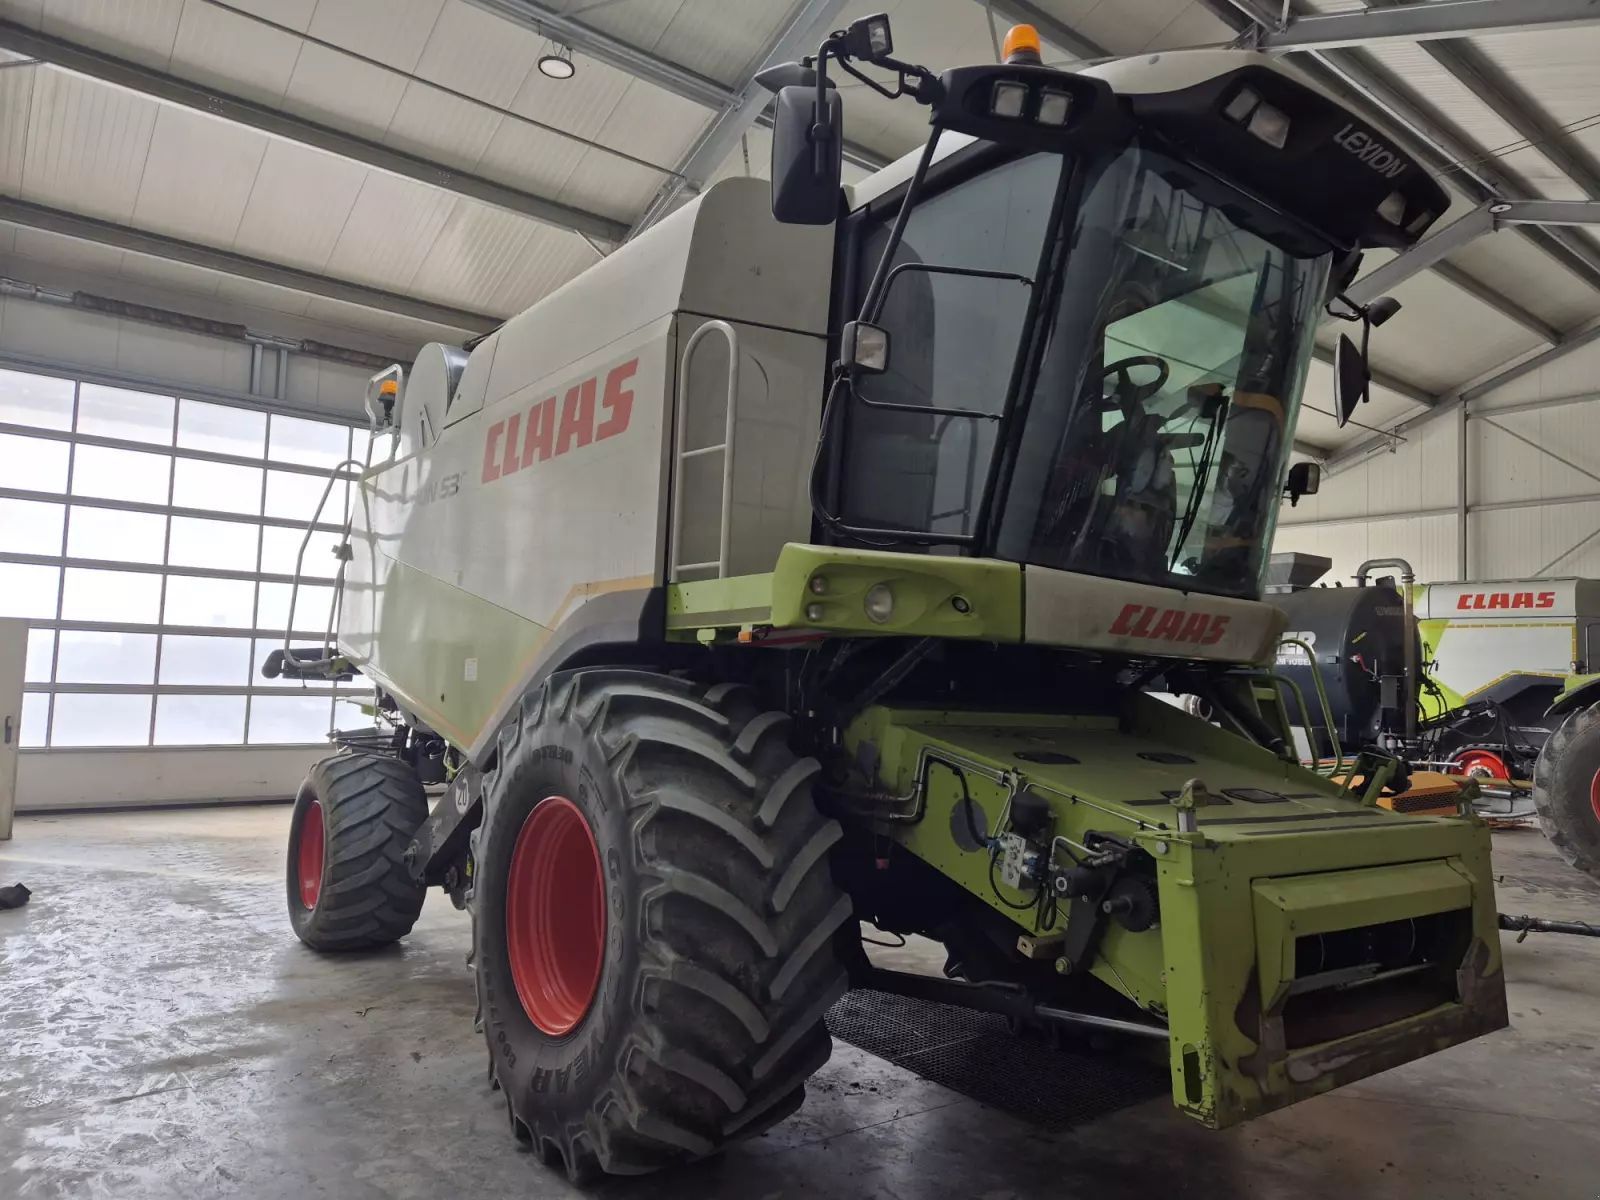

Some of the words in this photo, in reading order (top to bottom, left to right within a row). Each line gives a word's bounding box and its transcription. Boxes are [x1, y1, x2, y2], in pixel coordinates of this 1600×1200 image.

[1333, 123, 1408, 178] LEXION
[481, 357, 639, 484] CLAAS
[1457, 592, 1555, 610] CLAAS
[1108, 604, 1231, 646] CLAAS
[1276, 631, 1317, 655] ER
